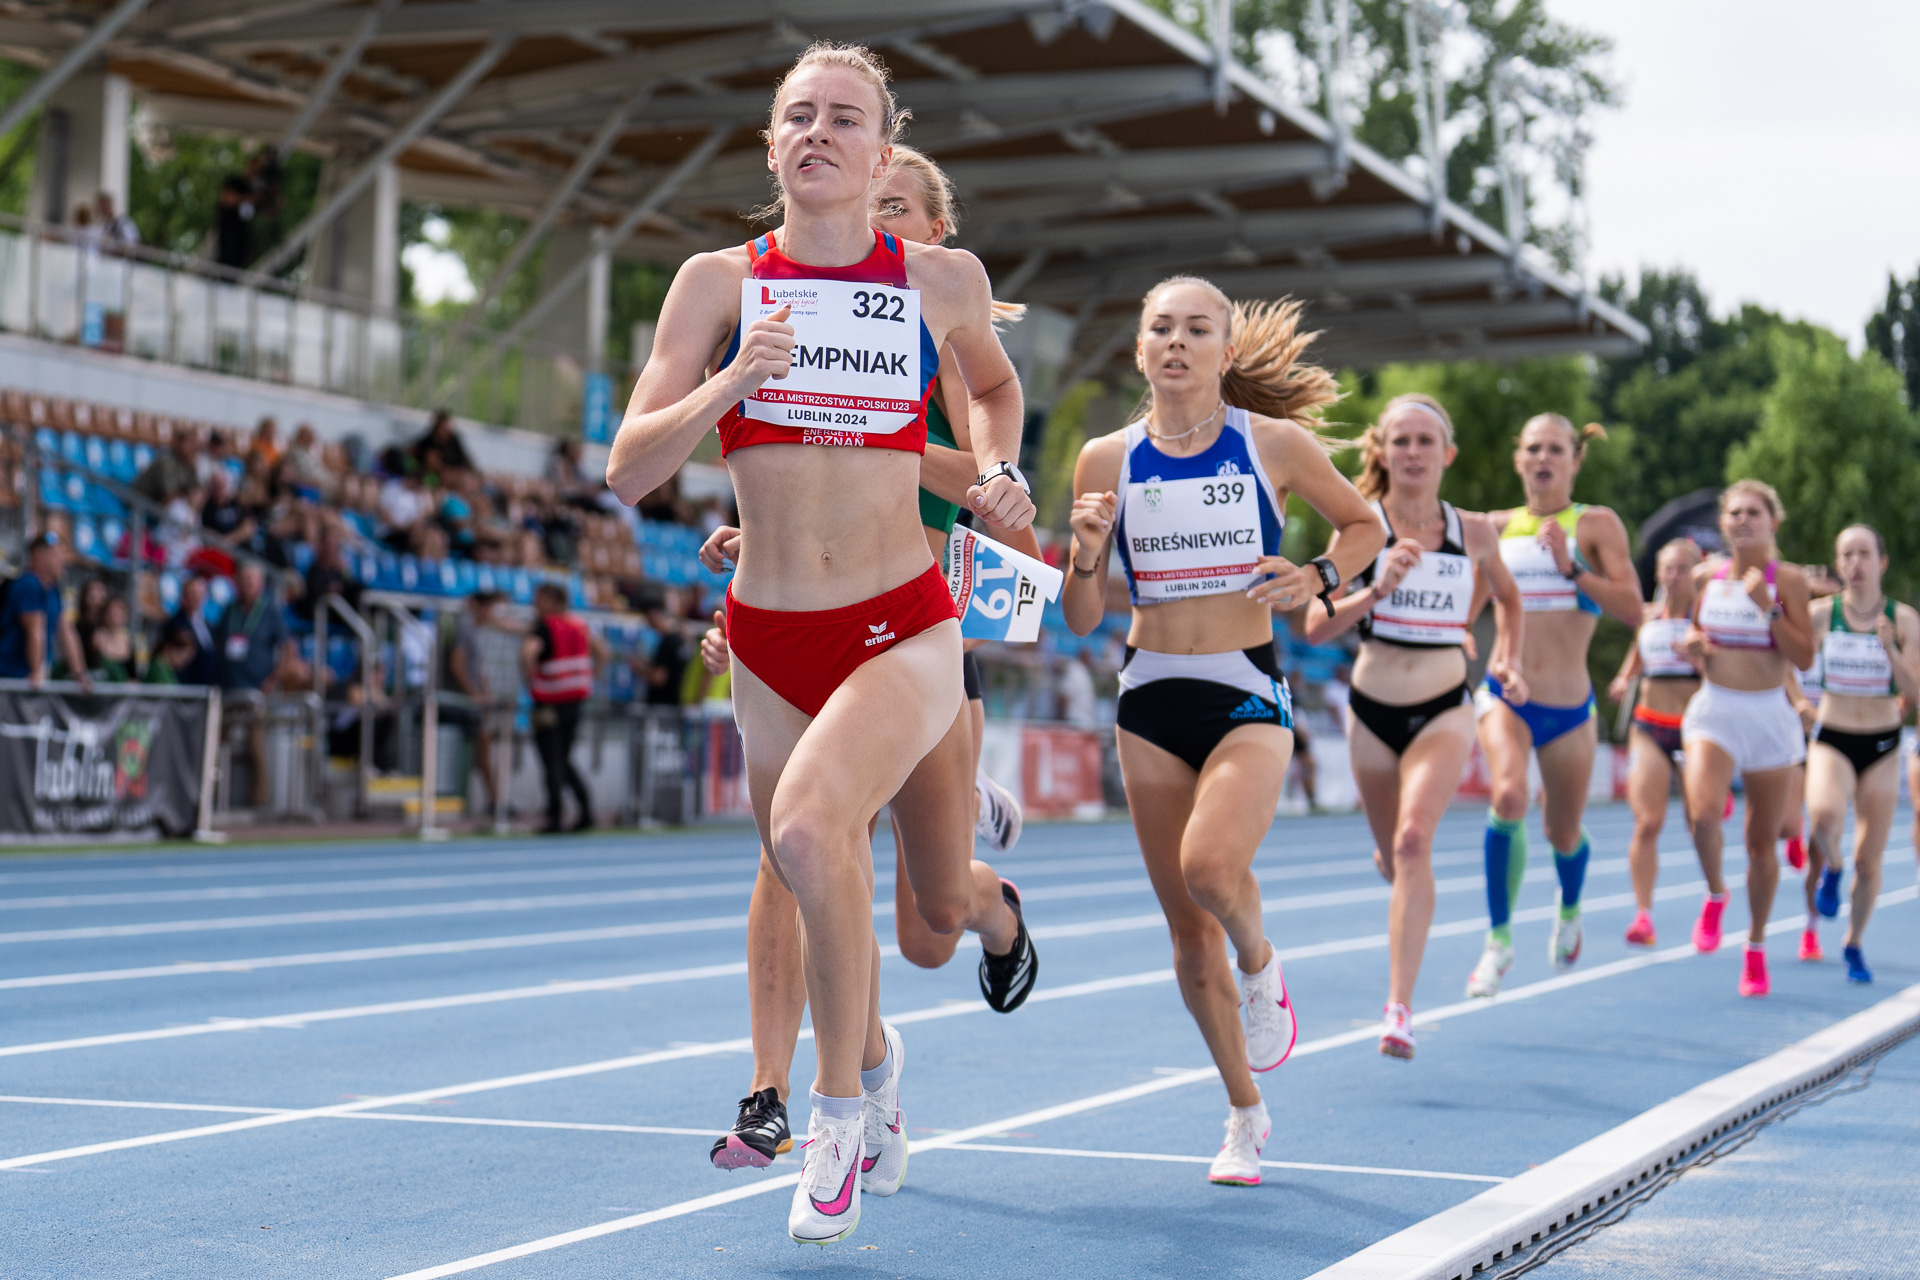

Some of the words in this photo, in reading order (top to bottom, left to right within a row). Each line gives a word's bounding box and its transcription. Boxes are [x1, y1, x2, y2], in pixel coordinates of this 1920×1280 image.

[773, 289, 818, 299] lubelskie
[852, 290, 906, 323] 322
[789, 345, 909, 377] EMPNIAK
[762, 392, 785, 401] PZLA
[786, 393, 855, 408] MISTRZOSTWA
[856, 400, 889, 410] POLSKI
[891, 402, 910, 411] U23
[787, 409, 832, 423] LUBLIN
[834, 413, 868, 426] 2024
[802, 435, 865, 447] POZNAŃ
[1202, 482, 1245, 506] 339
[1132, 528, 1256, 553] BEREŚNIEWICZ
[953, 540, 962, 577] LUBLIN
[961, 537, 974, 595] MISTRZOSTWA
[1162, 567, 1215, 579] MISTRZOSTWA
[1216, 566, 1241, 575] POLSKI
[1437, 559, 1464, 577] 267
[950, 580, 960, 598] 202
[1165, 581, 1200, 592] LUBLIN
[1202, 580, 1227, 589] 2024
[1391, 588, 1454, 610] BREZA
[864, 631, 896, 647] erima
[1229, 708, 1274, 719] adidas
